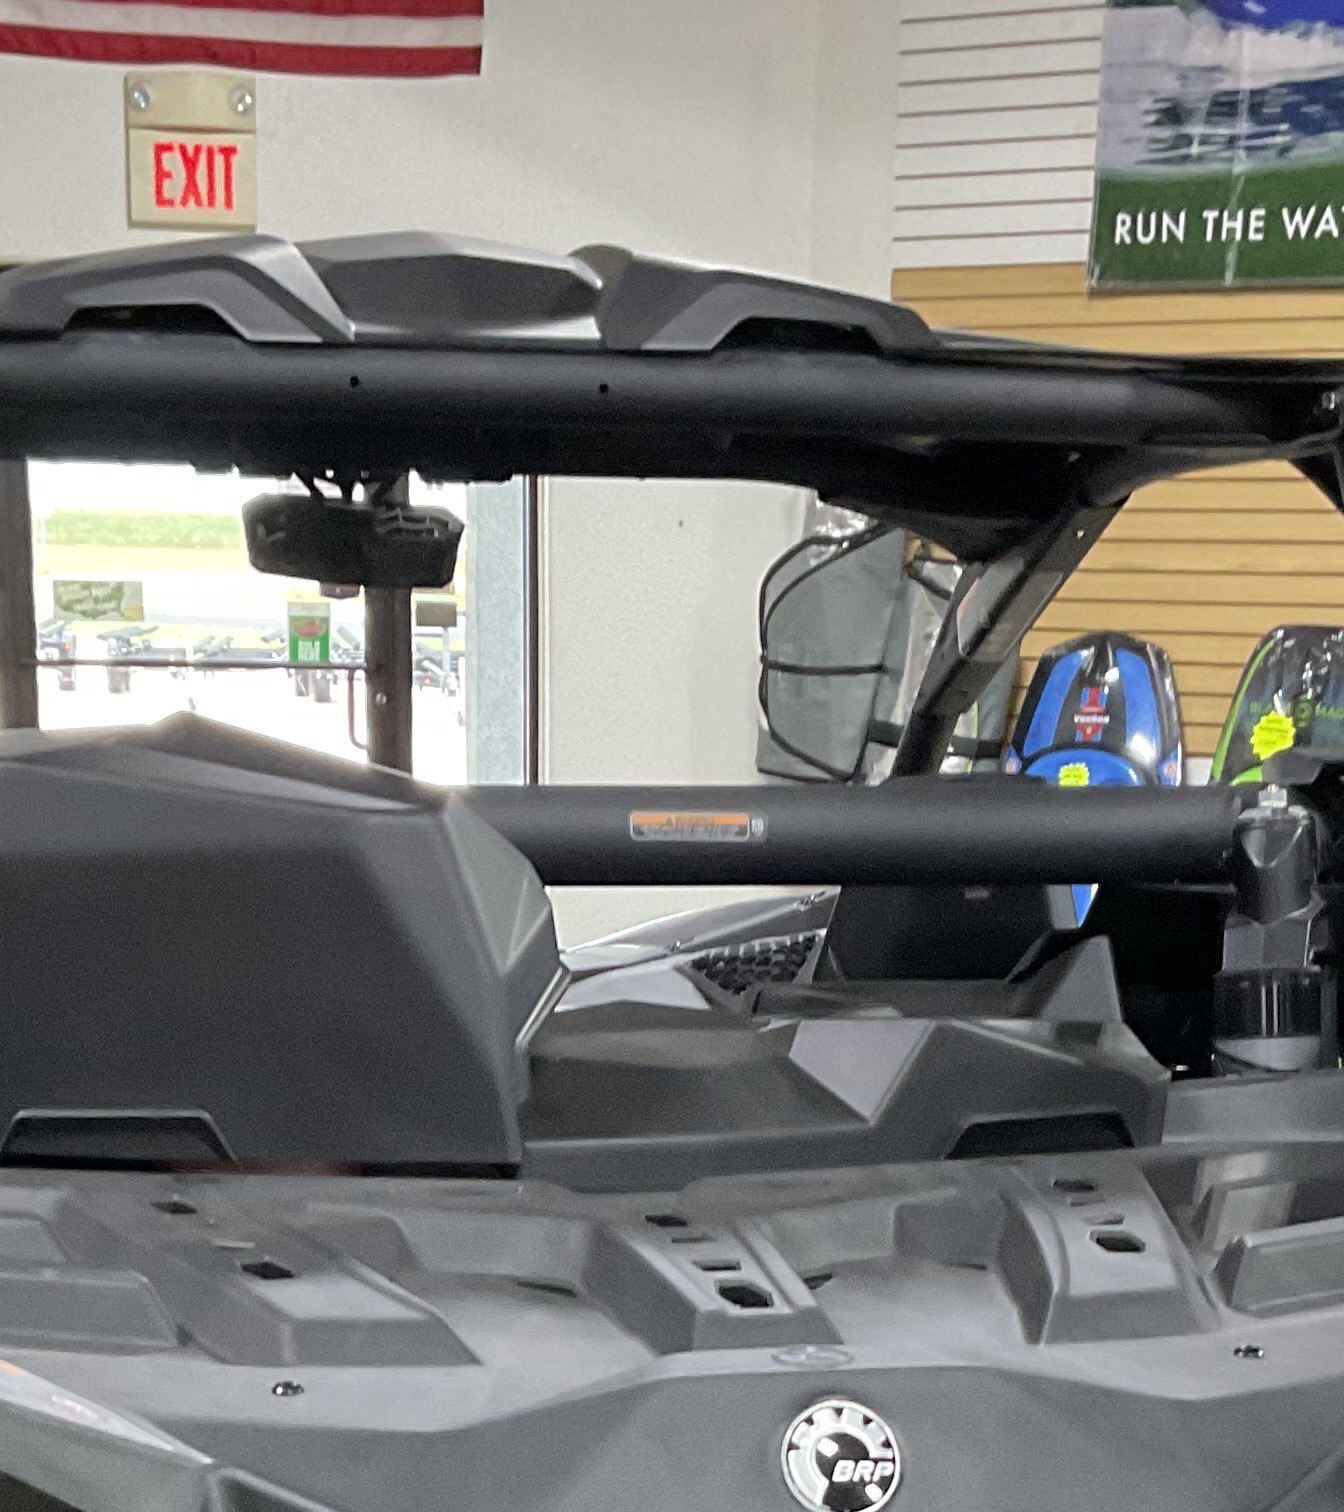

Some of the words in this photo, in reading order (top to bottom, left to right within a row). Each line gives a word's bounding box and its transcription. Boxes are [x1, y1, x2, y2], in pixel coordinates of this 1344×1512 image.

[153, 142, 239, 210] EXIT
[1114, 208, 1187, 245] RUN
[1202, 207, 1266, 242] THE
[831, 1459, 895, 1482] BRP
